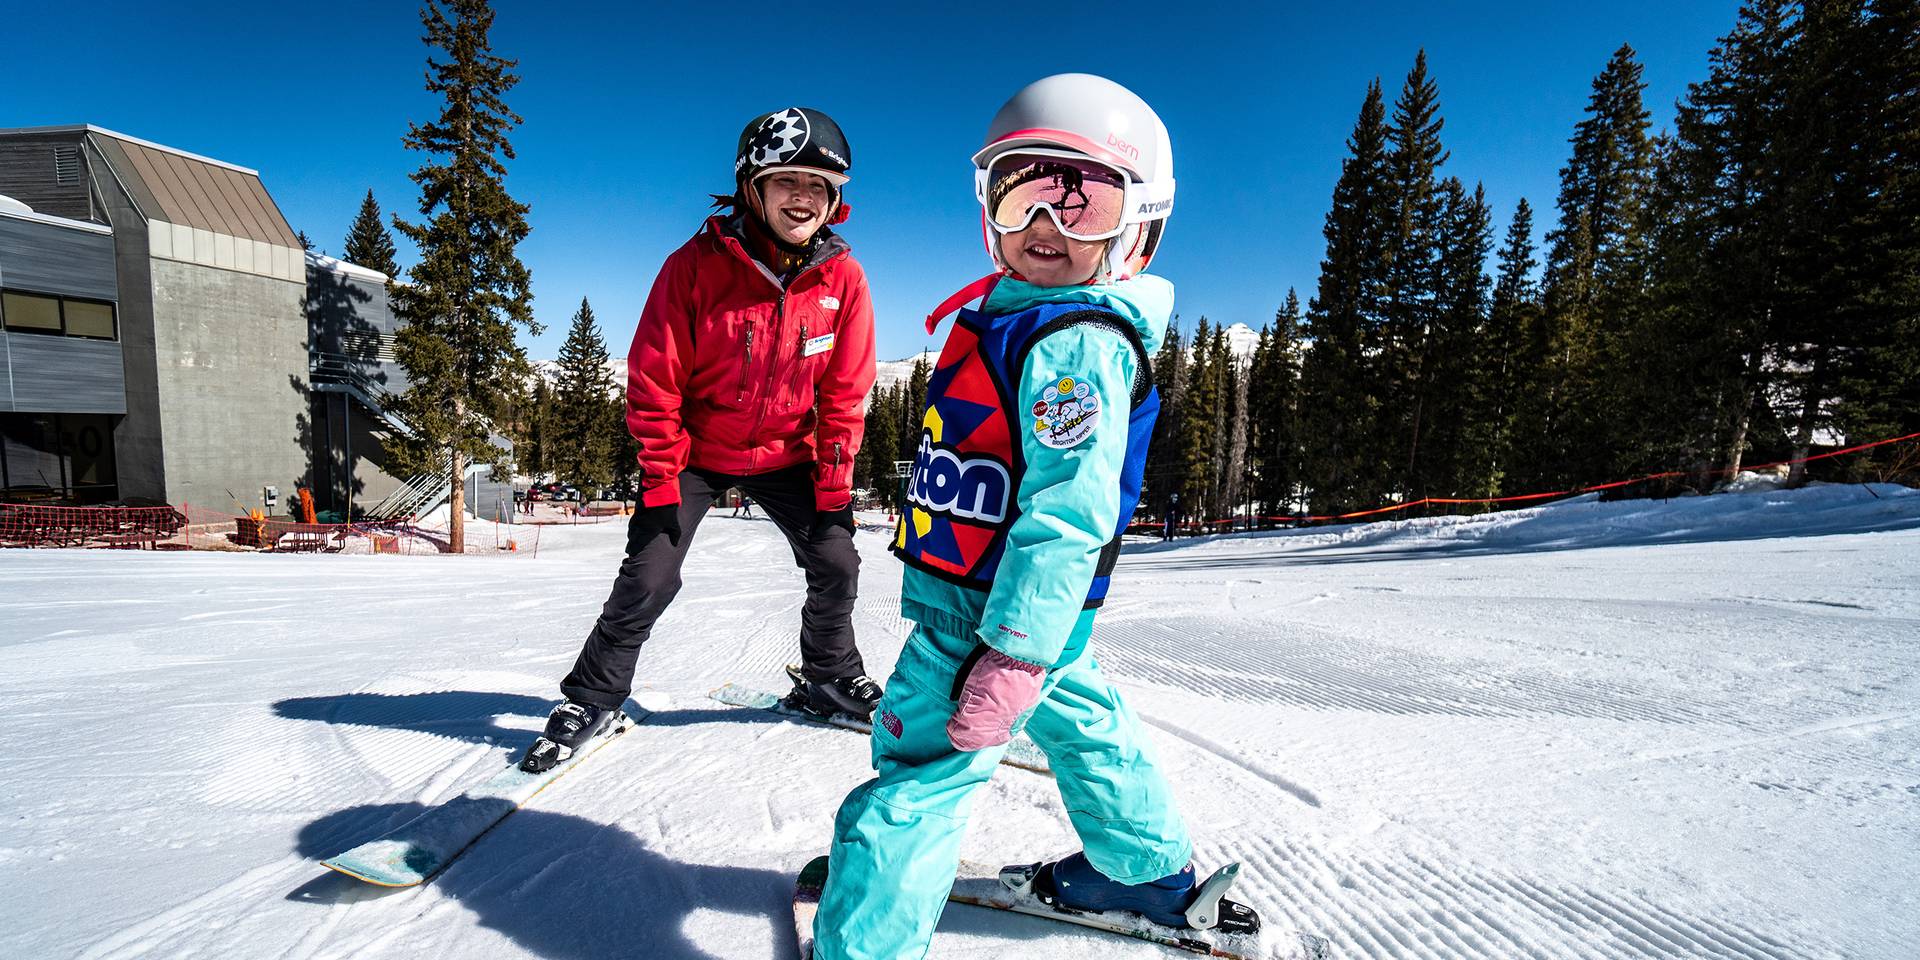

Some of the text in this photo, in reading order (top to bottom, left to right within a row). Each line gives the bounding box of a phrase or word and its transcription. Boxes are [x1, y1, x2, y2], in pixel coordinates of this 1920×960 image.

[1106, 133, 1139, 160] bern
[1138, 199, 1172, 214] ATOMIC
[1033, 404, 1048, 414] STOP
[1052, 437, 1076, 446] BRIGHTON
[1075, 425, 1091, 440] RIPPER
